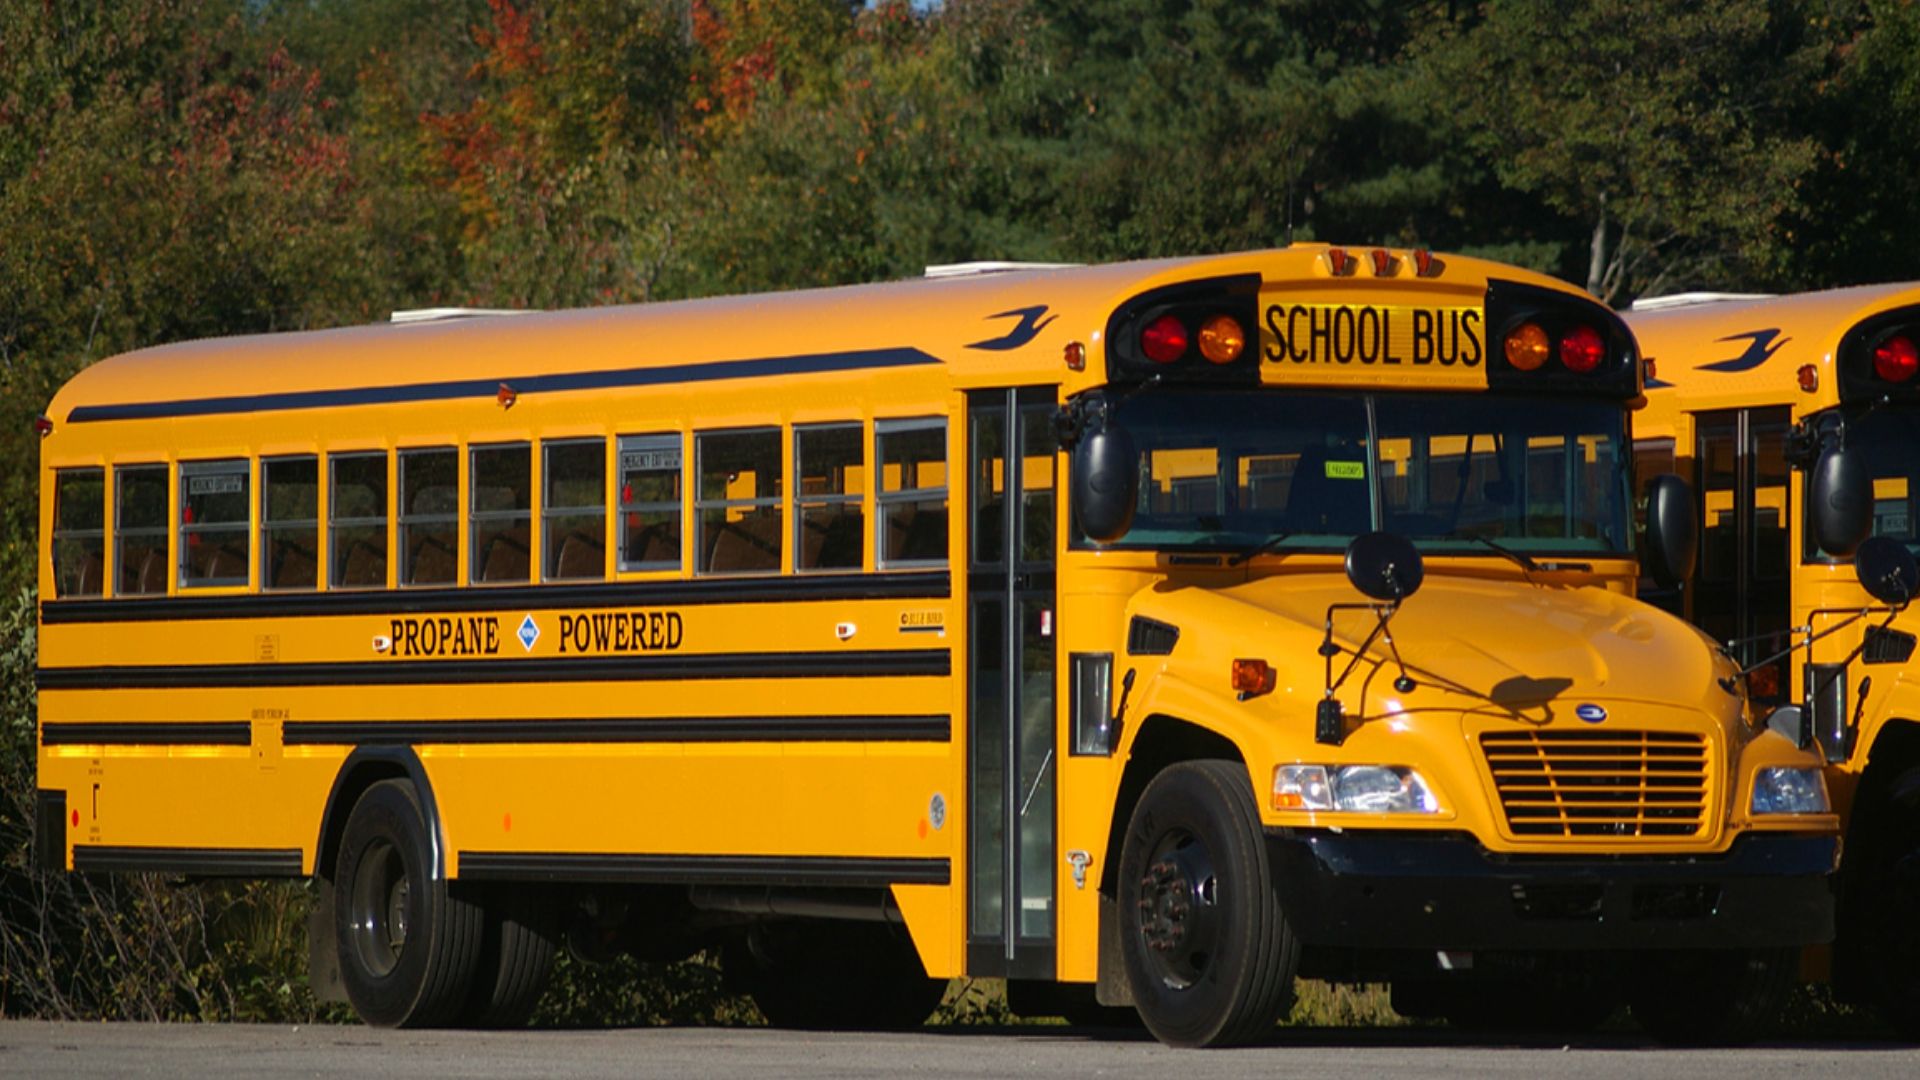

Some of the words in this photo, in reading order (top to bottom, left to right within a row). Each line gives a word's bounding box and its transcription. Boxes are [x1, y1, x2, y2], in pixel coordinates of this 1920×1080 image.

[1265, 304, 1401, 364] SCHOOL
[1413, 309, 1482, 366] BUS
[390, 617, 500, 656] PROPANE
[559, 612, 683, 652] POWERED
